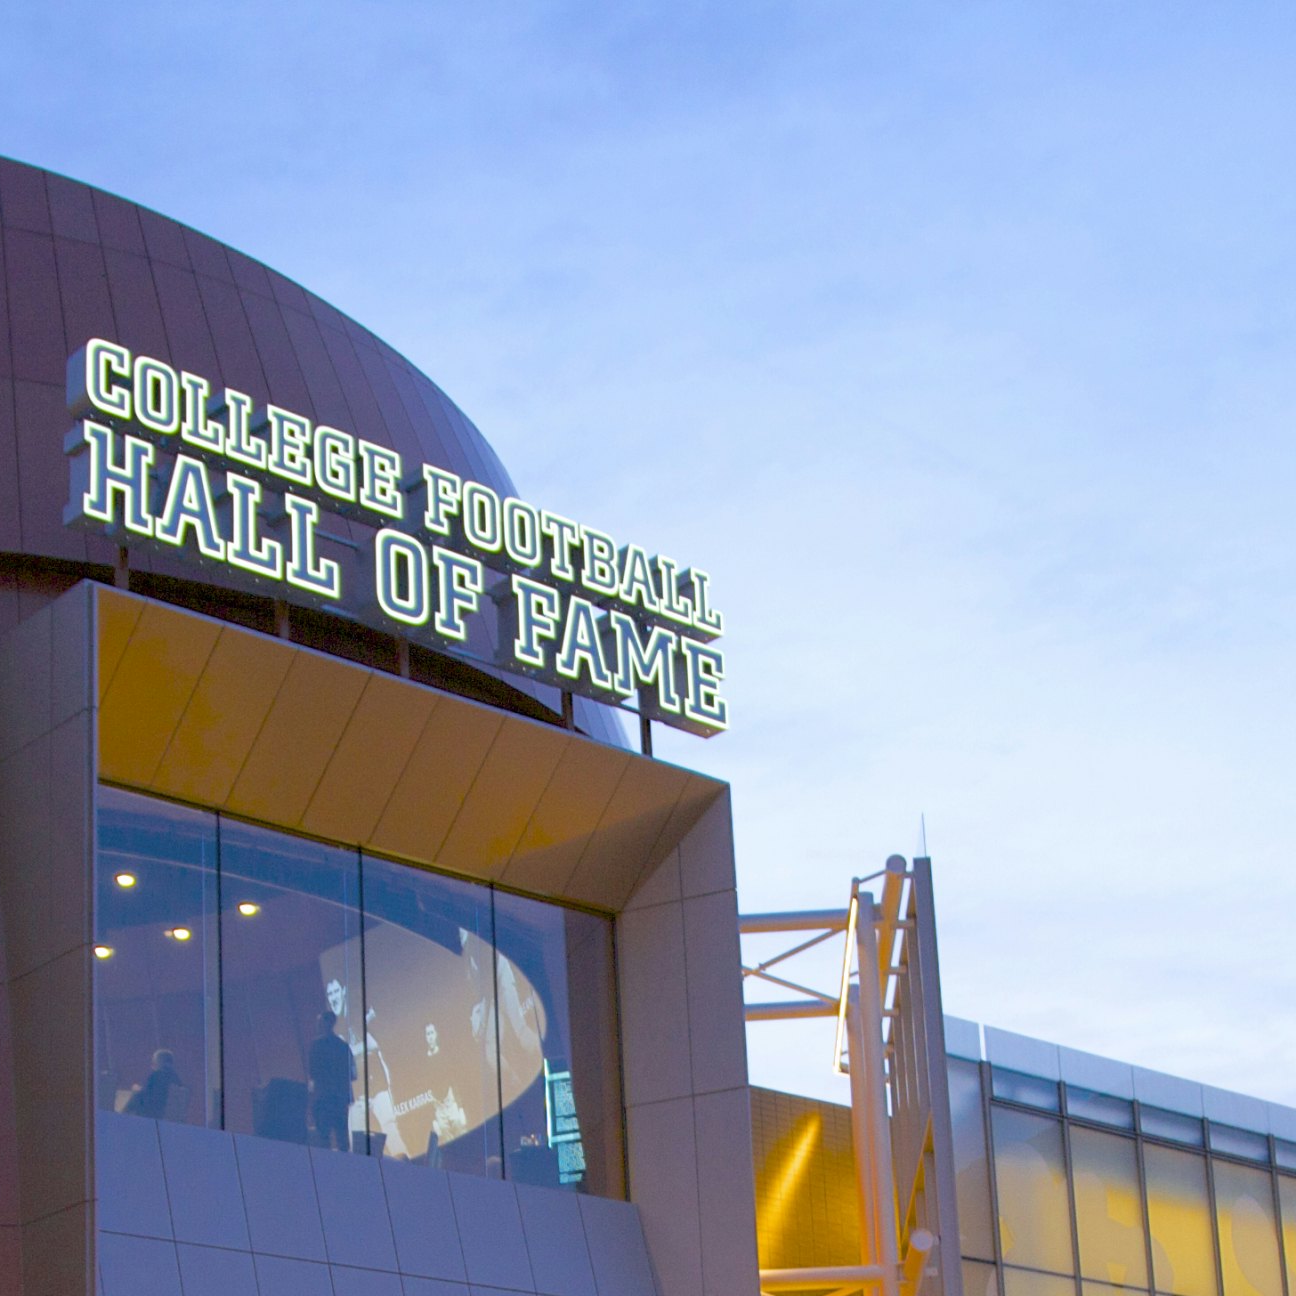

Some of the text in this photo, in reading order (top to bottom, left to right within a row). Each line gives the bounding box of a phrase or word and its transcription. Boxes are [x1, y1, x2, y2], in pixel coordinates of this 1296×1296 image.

[83, 419, 729, 730] HALL OF FAME
[85, 337, 724, 637] COLLEGE FOOTBALL
